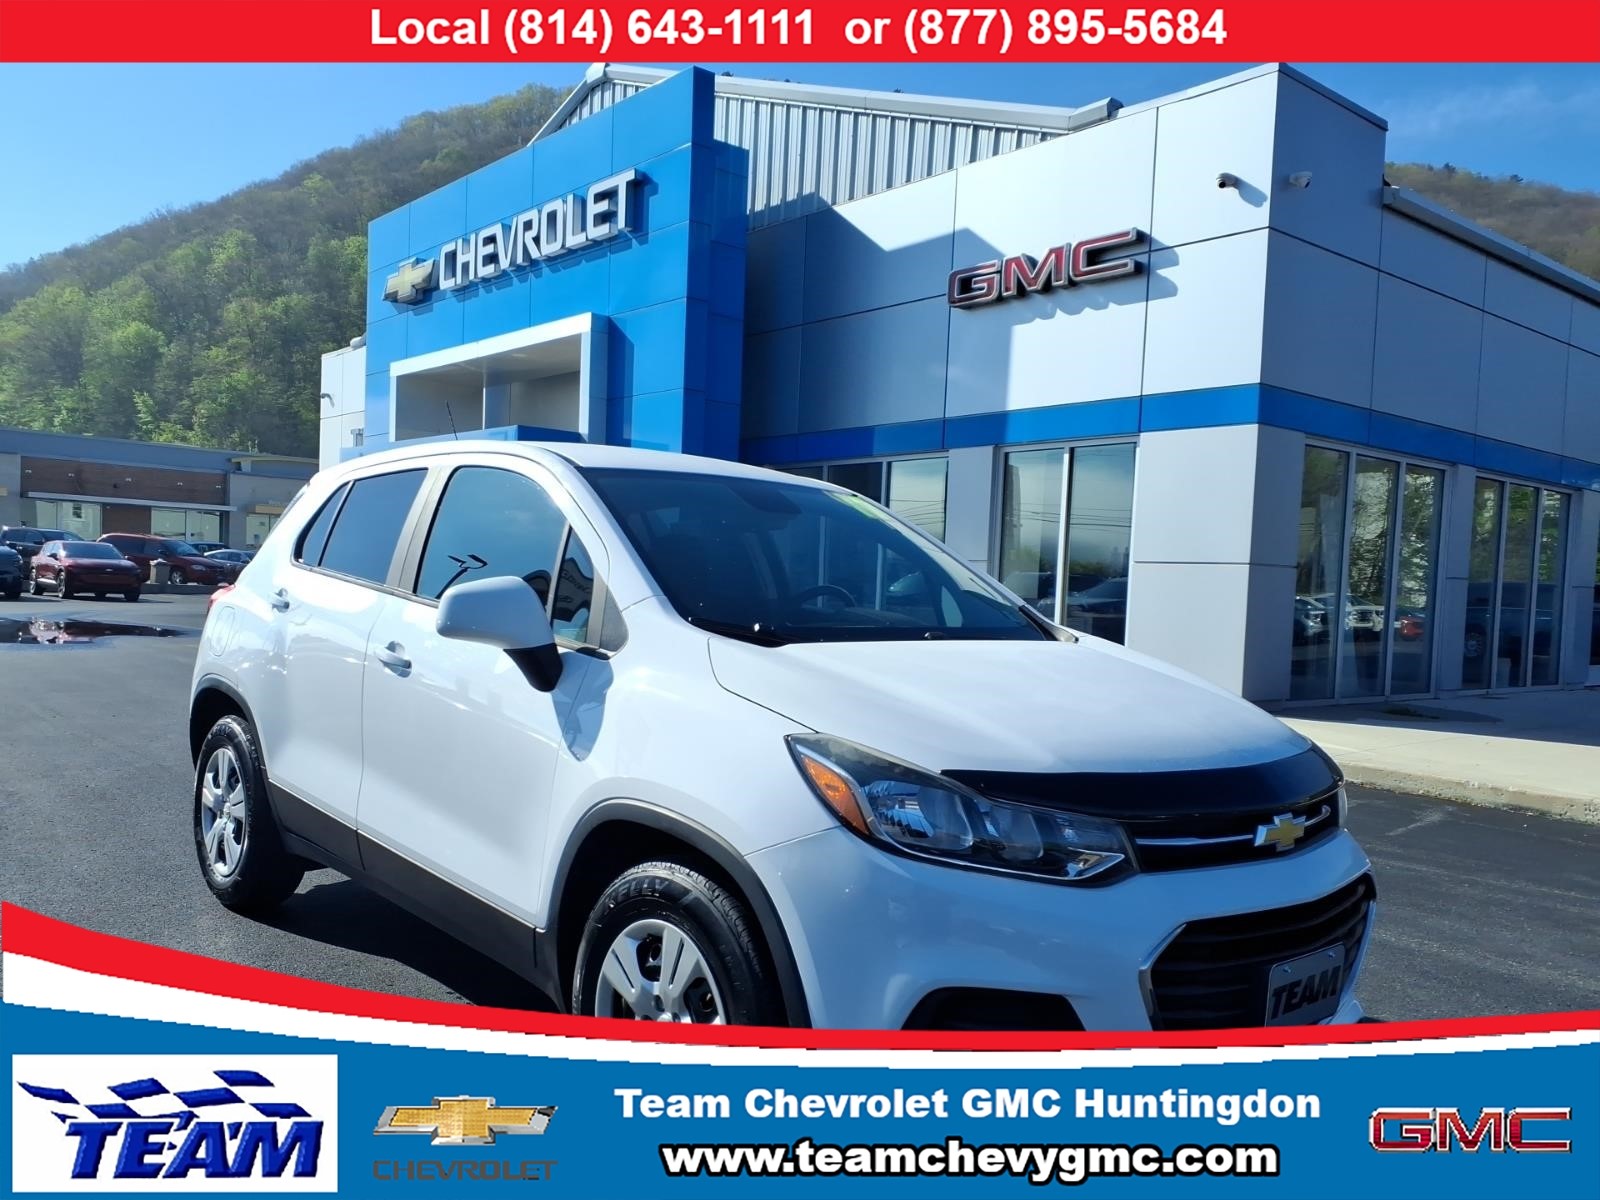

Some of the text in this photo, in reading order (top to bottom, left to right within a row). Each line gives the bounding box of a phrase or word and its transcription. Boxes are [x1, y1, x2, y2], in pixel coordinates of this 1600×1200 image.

[438, 167, 638, 291] CHEVROLET
[947, 226, 1139, 308] GMC
[1271, 964, 1342, 1020] TEAM
